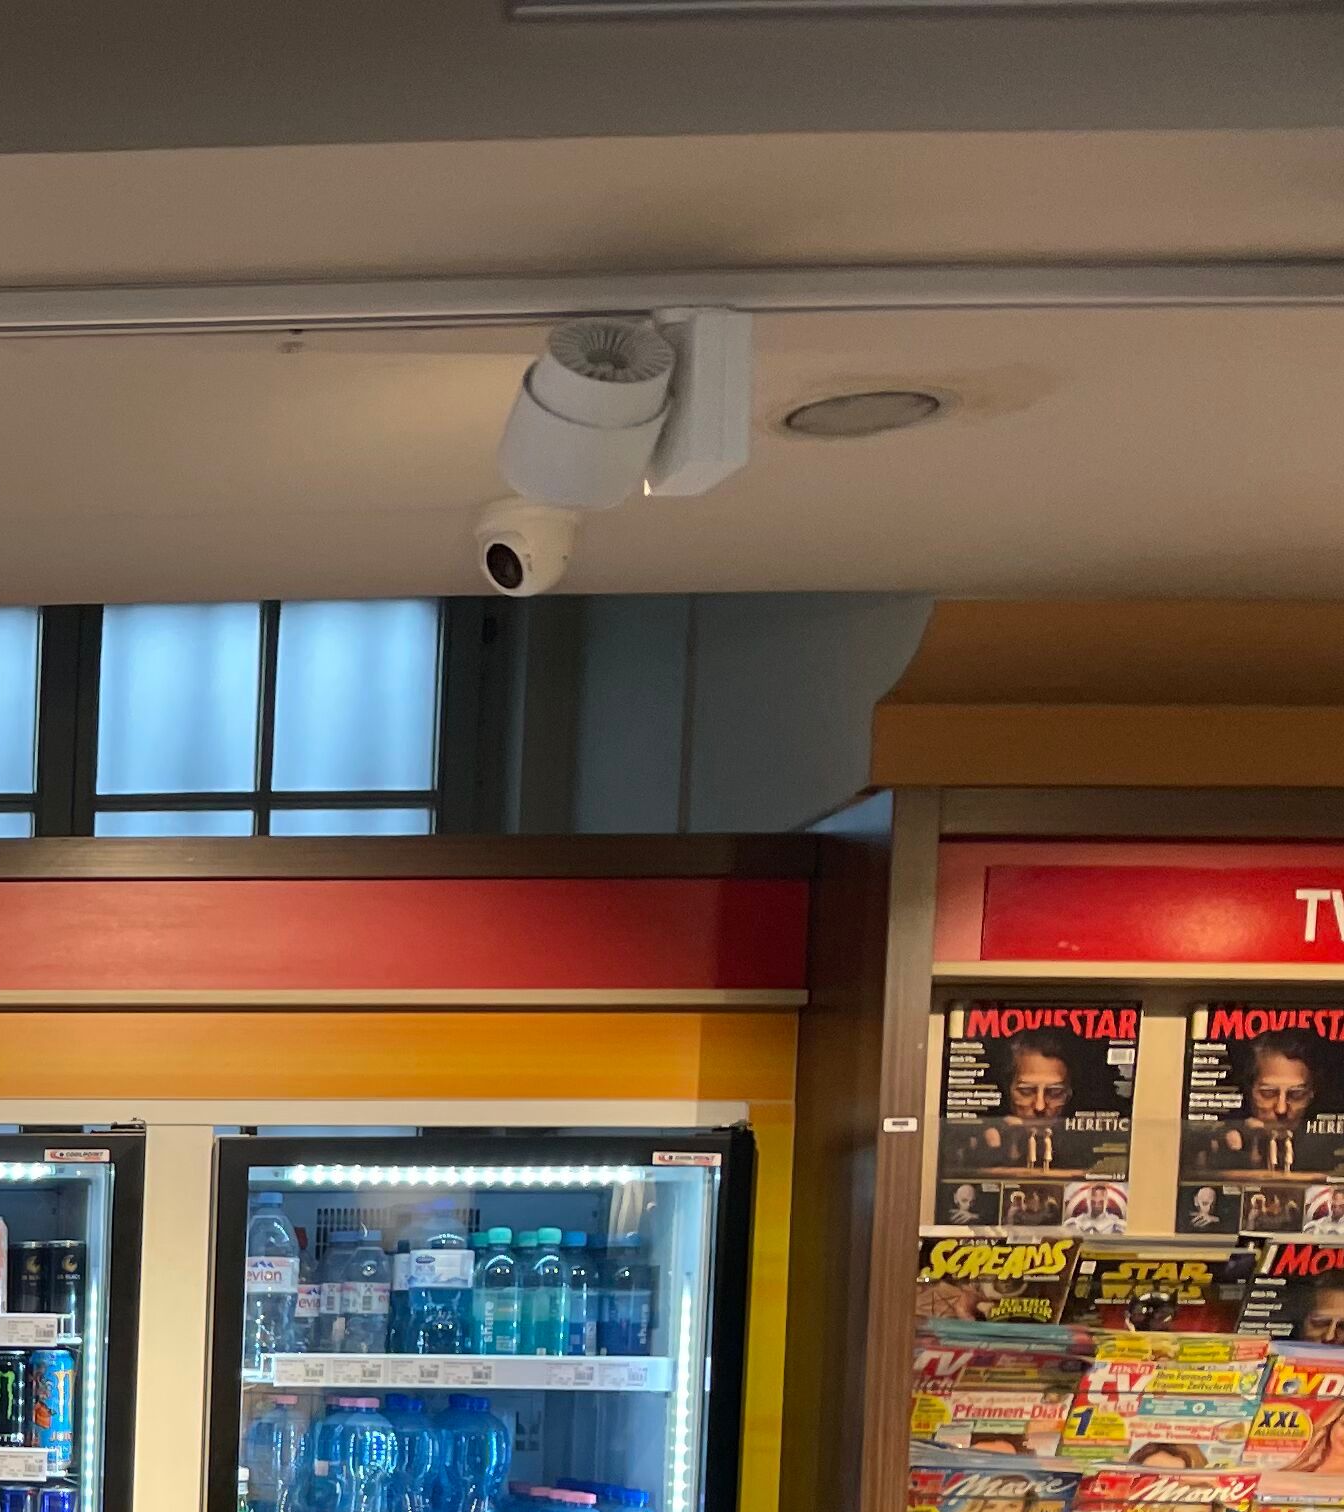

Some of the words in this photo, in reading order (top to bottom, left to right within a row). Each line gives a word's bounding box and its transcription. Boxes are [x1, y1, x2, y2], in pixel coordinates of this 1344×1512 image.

[967, 1009, 1137, 1041] MOVIESTAR
[1210, 1010, 1344, 1042] MOVIEST
[1065, 1117, 1129, 1132] HERETIC
[1306, 1120, 1344, 1134] HERE
[921, 1238, 1076, 1281] SCREAMS
[1102, 1261, 1212, 1281] STAR
[952, 1403, 1068, 1420] Pfannen-Diät
[1259, 1411, 1301, 1429] XXL
